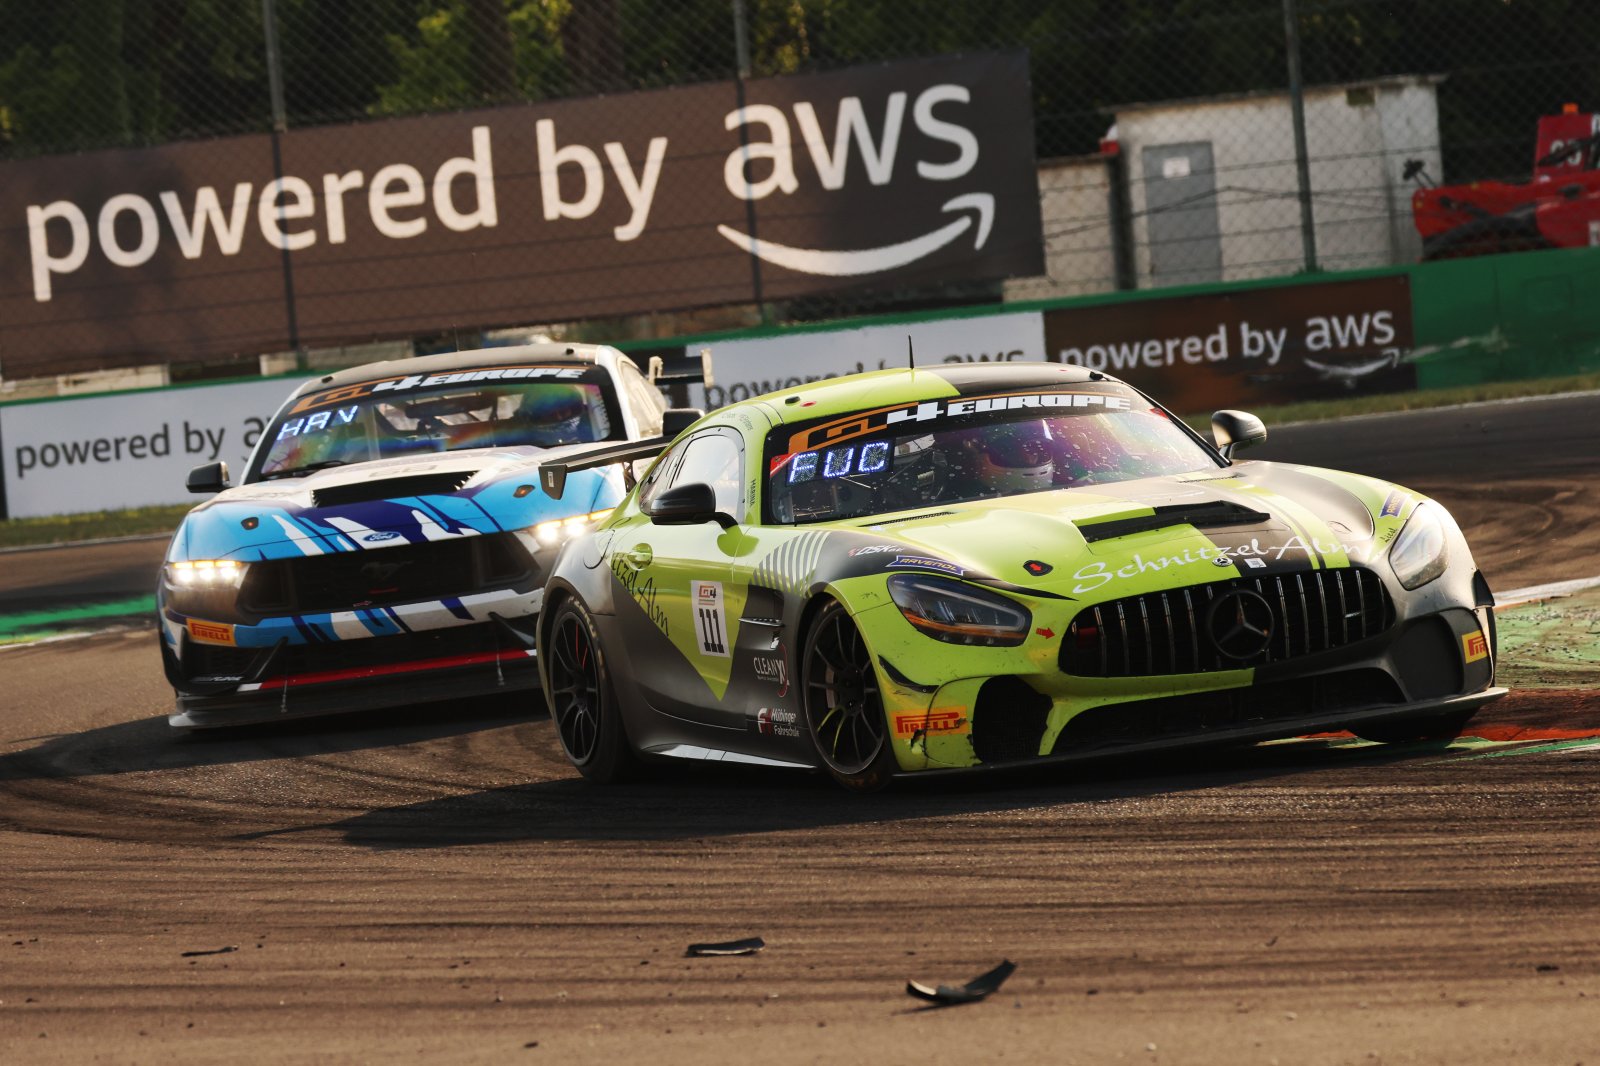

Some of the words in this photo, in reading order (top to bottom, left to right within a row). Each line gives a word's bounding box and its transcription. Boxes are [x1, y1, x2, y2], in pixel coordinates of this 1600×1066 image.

[26, 126, 498, 302] powered
[534, 118, 669, 242] by
[723, 84, 980, 201] aws
[1240, 321, 1287, 365] by
[1305, 310, 1396, 351] aws
[420, 368, 588, 388] EUROPE
[276, 405, 358, 441] HAV
[947, 394, 1131, 417] EUROPE
[15, 423, 170, 479] powered
[183, 421, 225, 460] by
[789, 442, 889, 484] FUC
[899, 558, 958, 571] RAVENOL
[1072, 539, 1268, 594] Schnitzel
[191, 623, 230, 641] PIRELLI
[698, 608, 725, 653] 111
